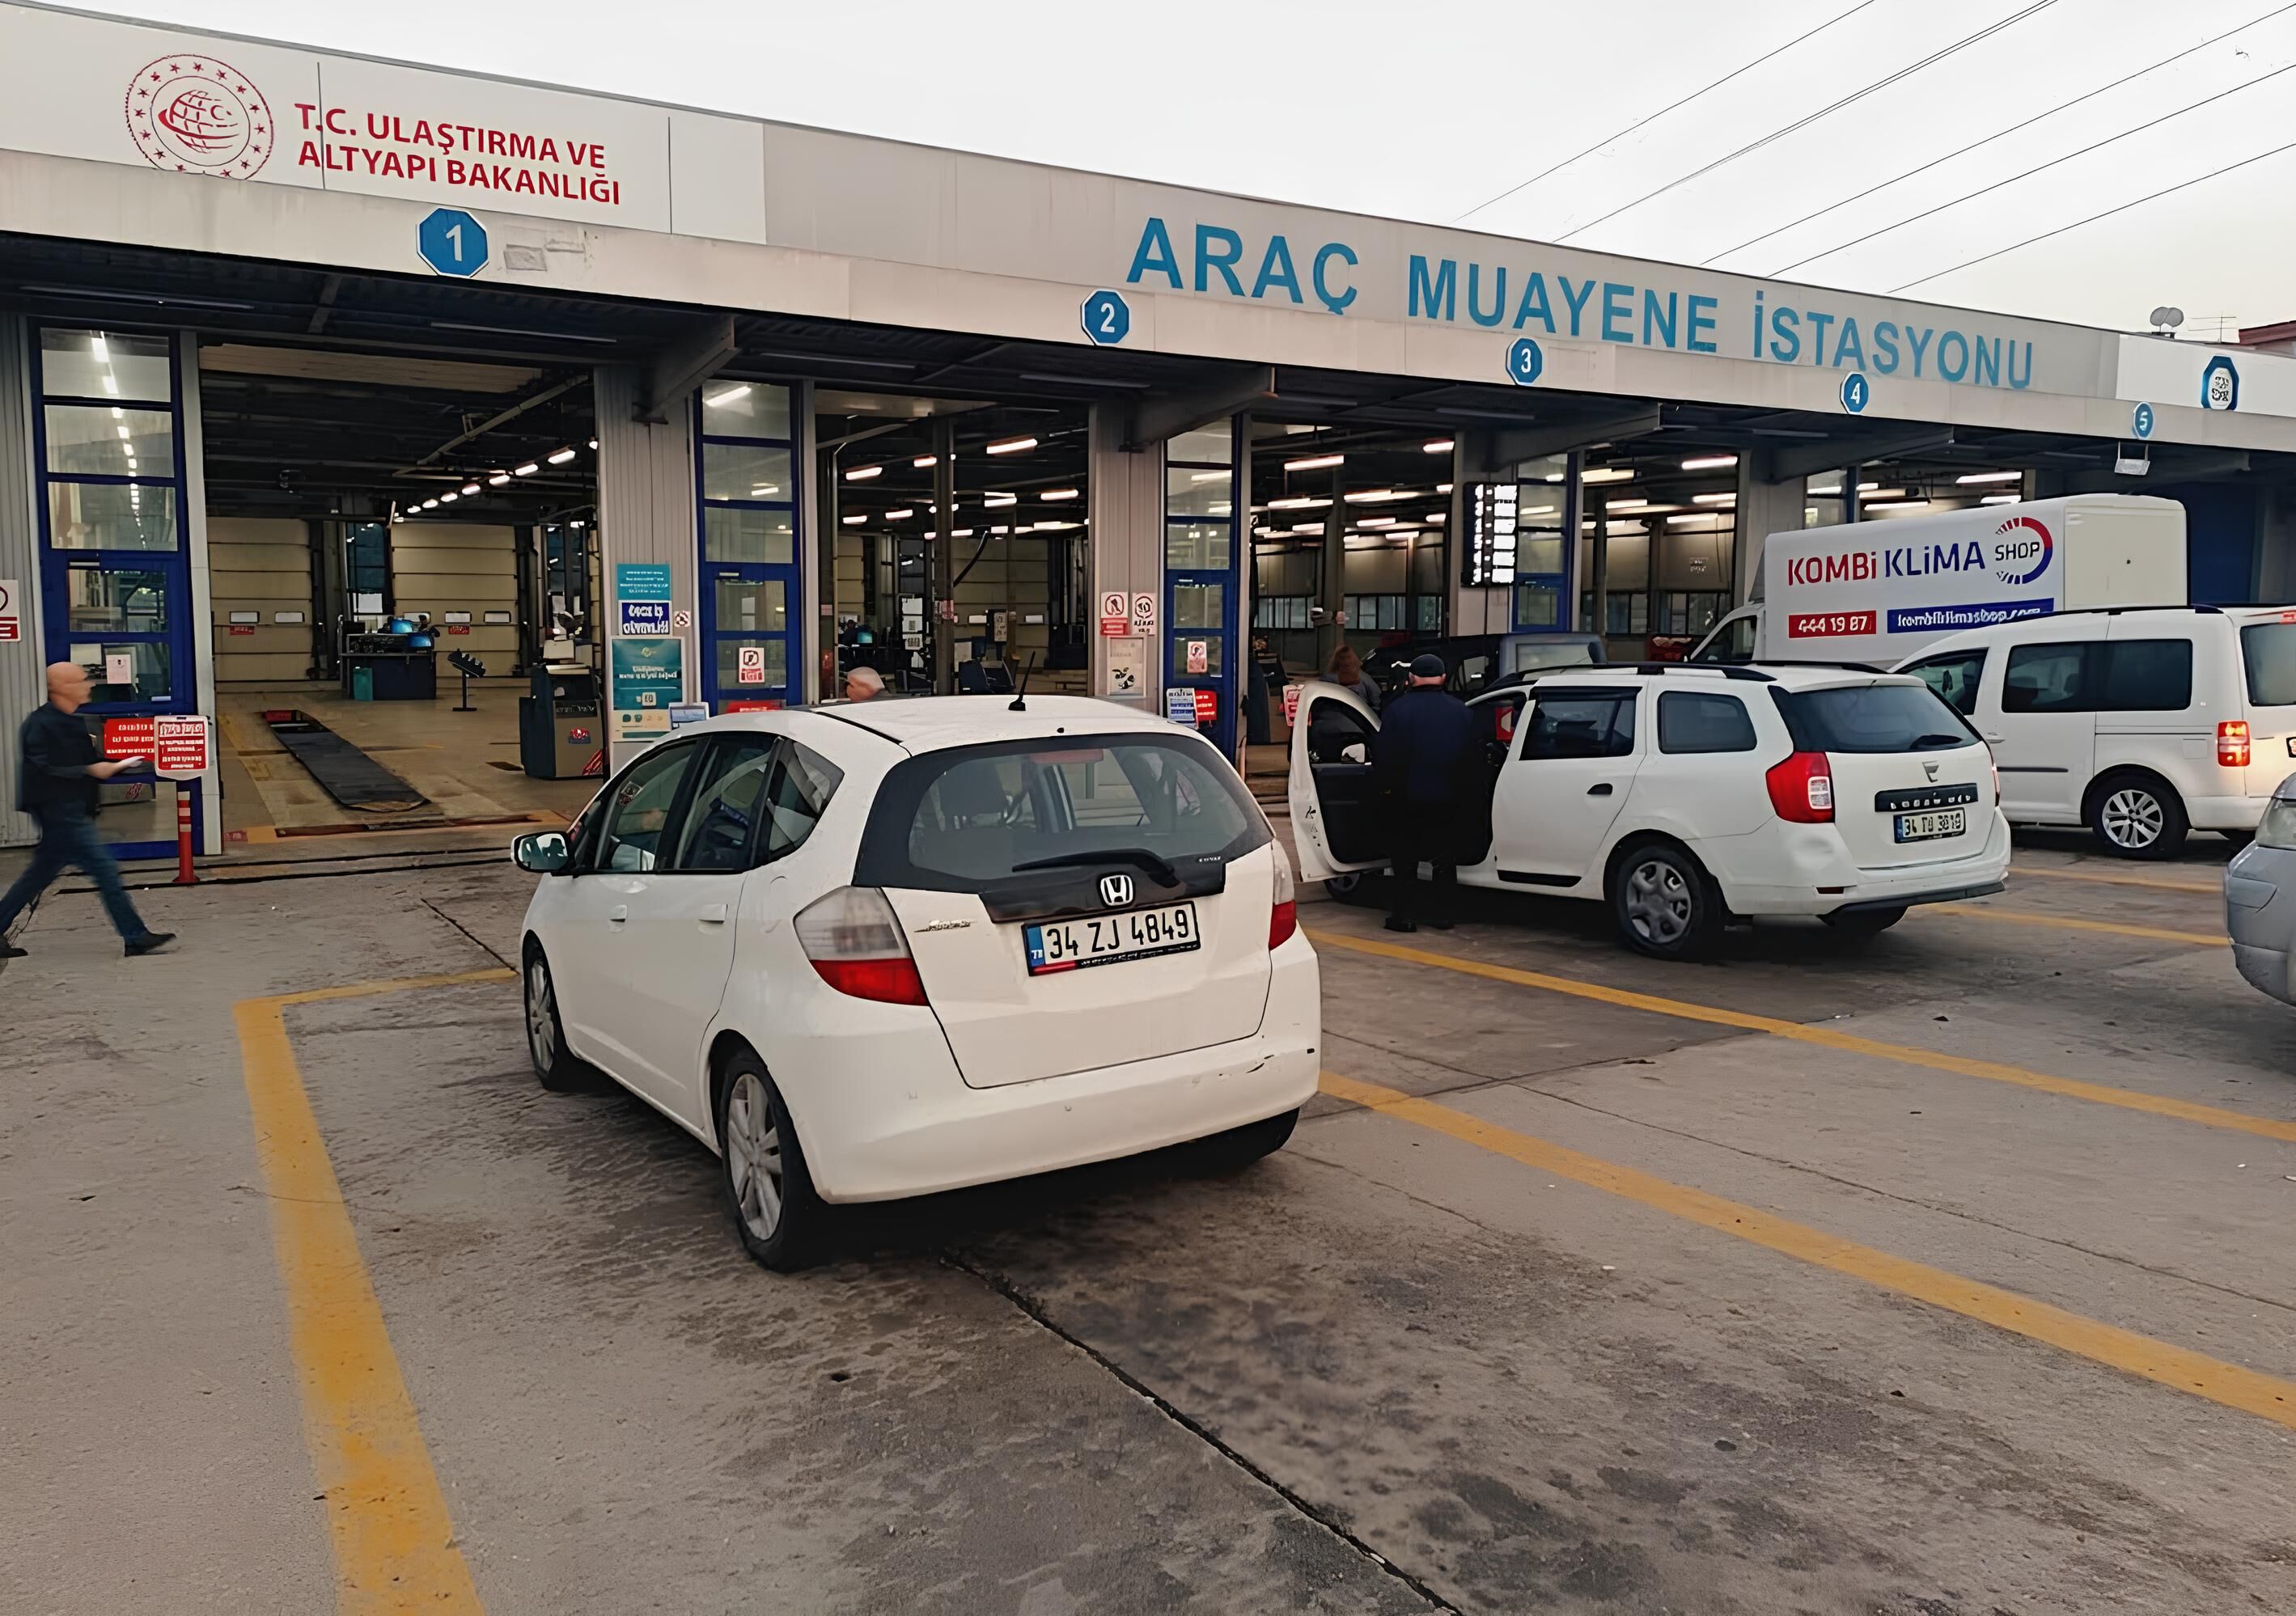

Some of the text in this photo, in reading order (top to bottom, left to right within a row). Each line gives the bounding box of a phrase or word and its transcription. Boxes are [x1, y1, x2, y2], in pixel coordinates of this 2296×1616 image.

[294, 104, 605, 169] T.C. ULAŞTIRMA VE
[298, 141, 620, 205] ALTYAPI BAKANLIĞI
[446, 224, 463, 261] 1
[1100, 302, 1116, 333] 2
[1126, 218, 2032, 389] ARAÇ MUAYENE İSTASYONU
[1520, 348, 1532, 373] 3
[1850, 382, 1862, 404] 4
[2139, 411, 2148, 431] 5
[1994, 541, 2040, 561] SHOP
[1830, 616, 1845, 632] 19
[1849, 616, 1868, 631] 87
[1047, 926, 1079, 959] 34
[1087, 919, 1120, 953] ZJ
[1131, 909, 1190, 945] 4849
